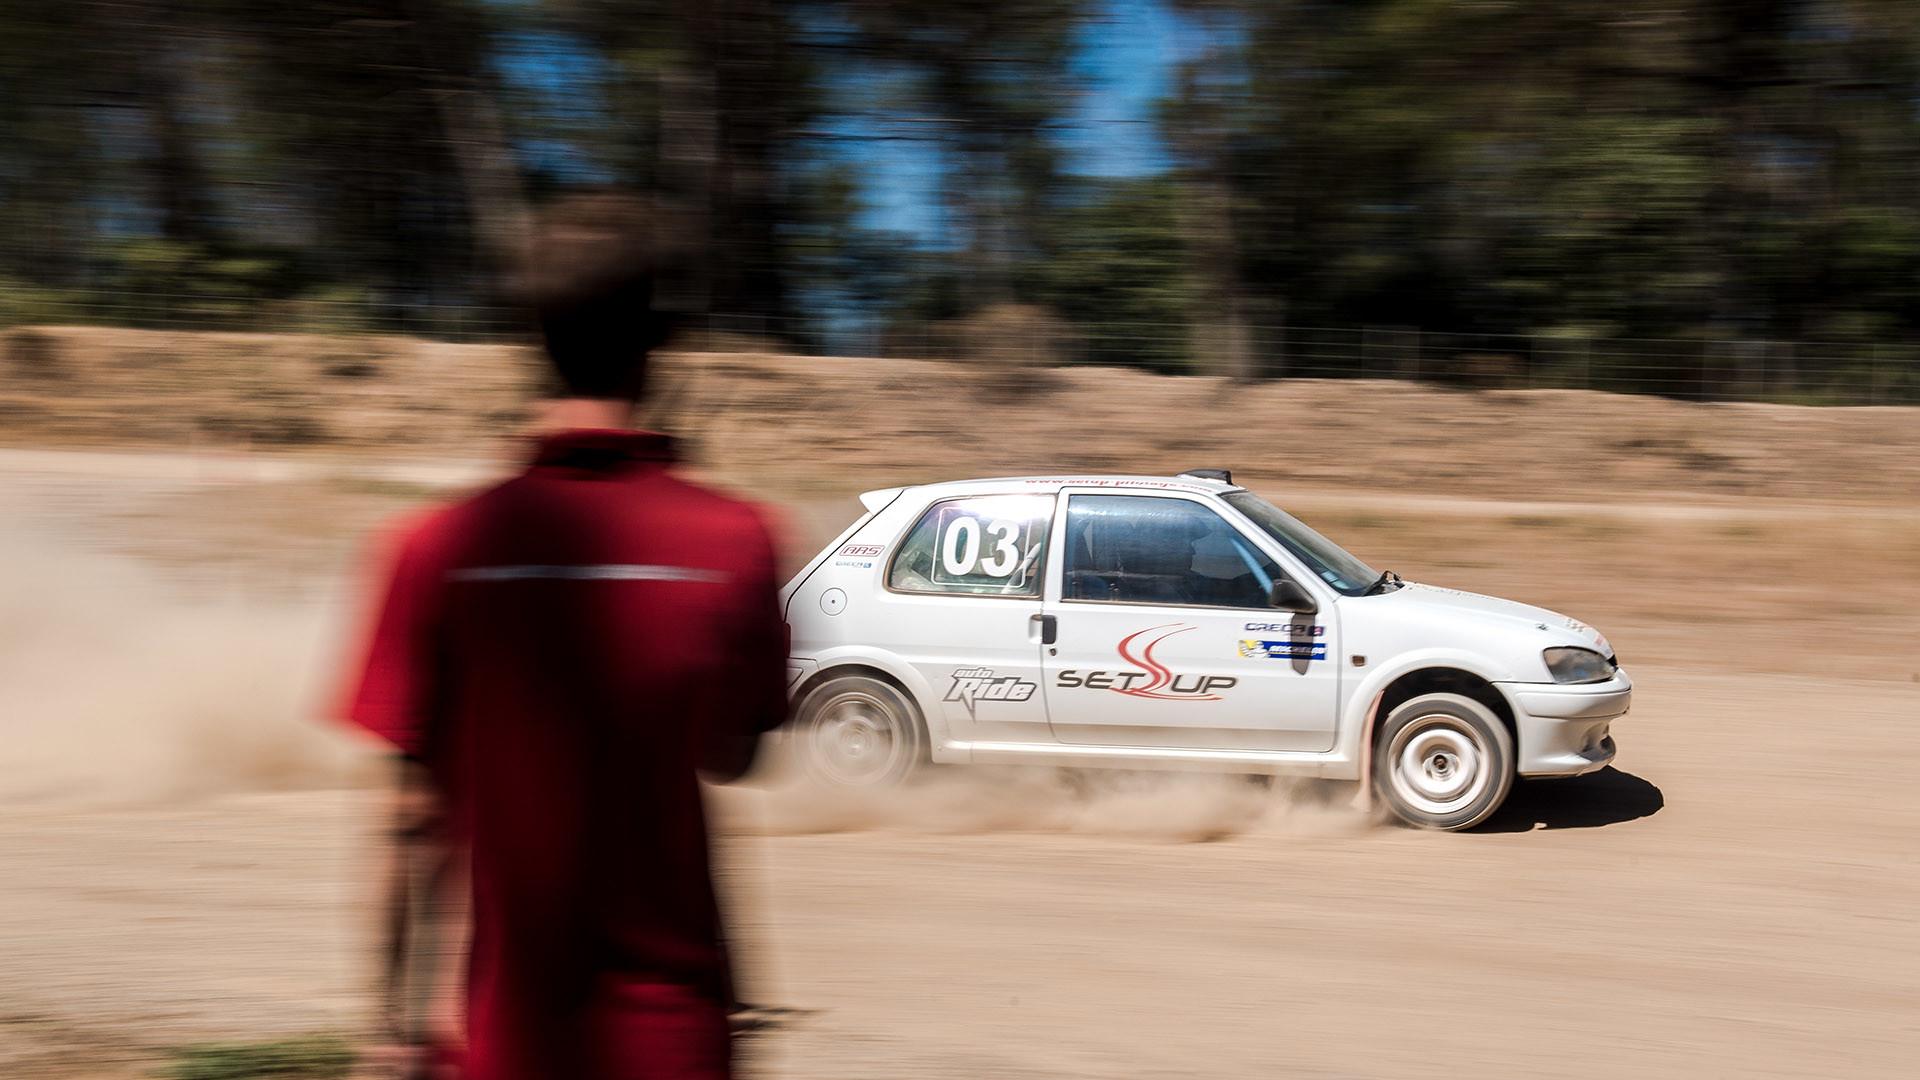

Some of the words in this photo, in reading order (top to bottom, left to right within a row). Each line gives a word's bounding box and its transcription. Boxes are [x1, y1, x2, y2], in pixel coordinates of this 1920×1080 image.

[943, 516, 1020, 577] 03
[951, 667, 995, 679] auto
[943, 677, 1037, 720] Ride
